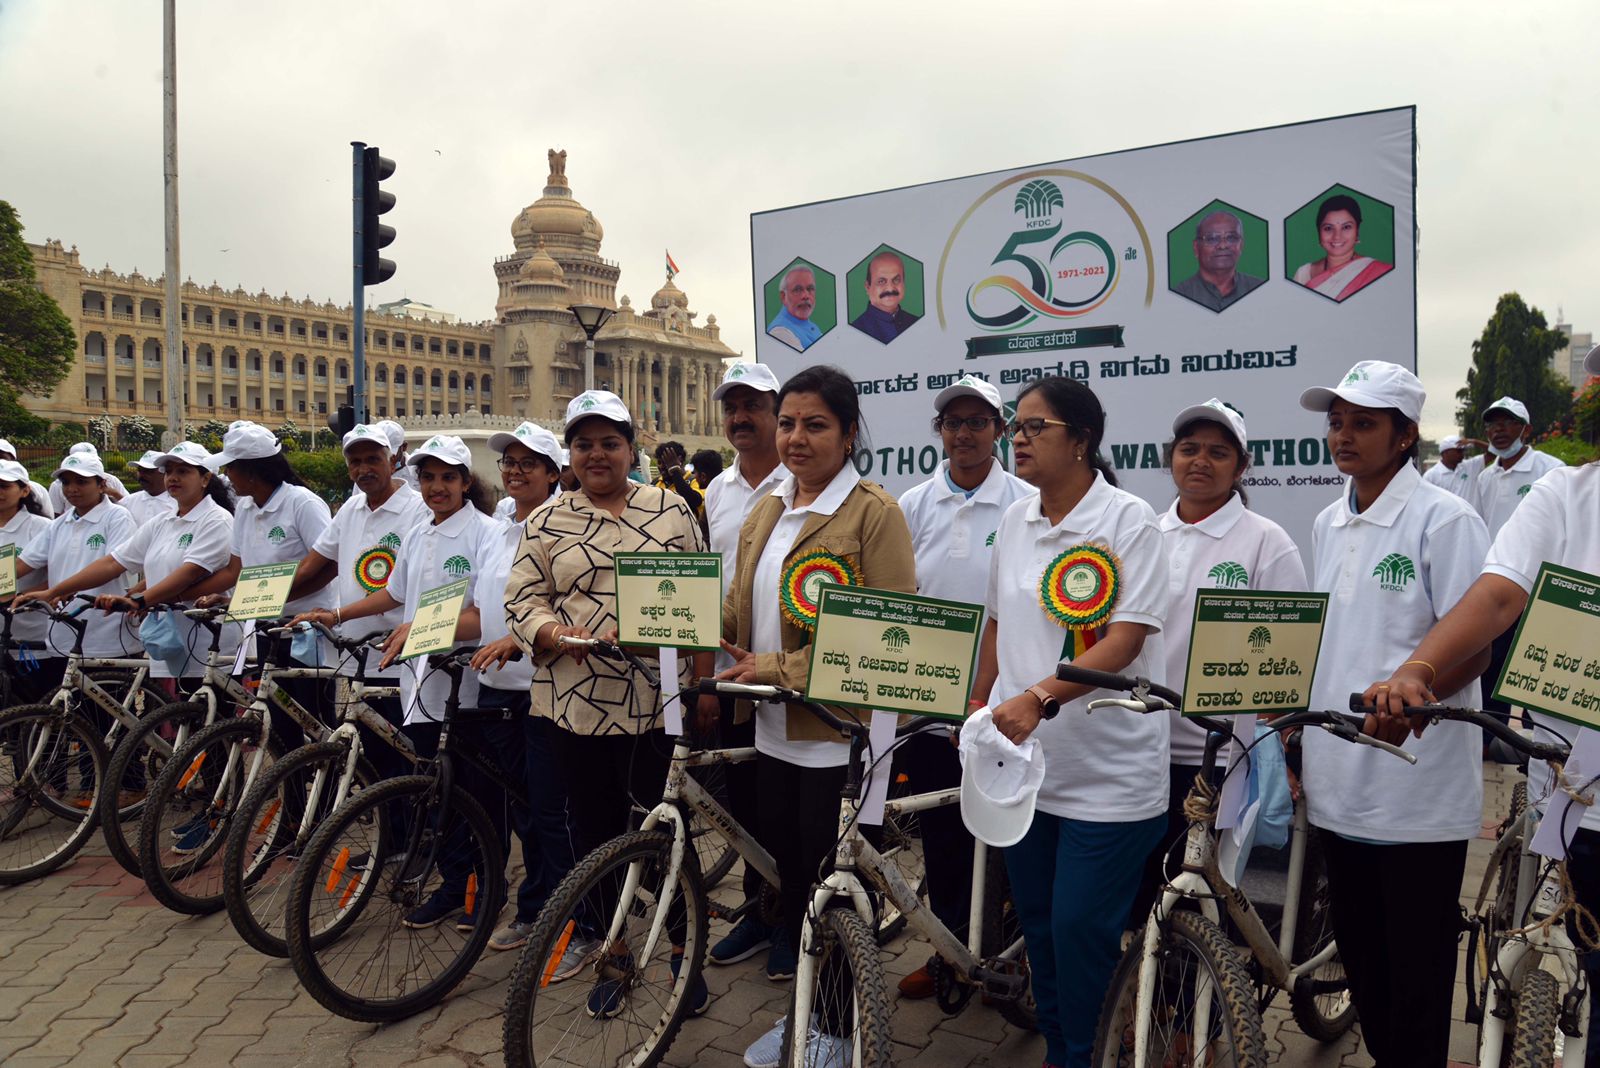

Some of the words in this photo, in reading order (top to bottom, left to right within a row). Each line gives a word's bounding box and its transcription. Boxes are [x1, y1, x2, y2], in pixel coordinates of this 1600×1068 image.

[1026, 219, 1052, 229] KFDC
[1057, 266, 1106, 279] 1971-2021
[1008, 331, 1077, 350] ವರ್ಷಾಚರಣೆ
[854, 372, 919, 396] ರ್ನಾಟಕ
[1100, 354, 1170, 378] ನಿಗಮ
[1181, 345, 1298, 373] ನಿಯಮಿತ
[1287, 475, 1345, 487] ಬೆಂಗಳೂರು
[1380, 584, 1405, 592] KFDCL
[1551, 576, 1596, 597] ಕರ್ನಾಟಕ
[640, 605, 666, 621] ಅಕ್ಷರ
[638, 625, 672, 638] ಪರಿಸರ
[677, 627, 699, 644] ಚಿನ್ನ
[822, 650, 851, 674] ನಮ್ಮ
[858, 655, 909, 674] ನಿಜವಾದ
[915, 661, 961, 685] ಸಂಪತ್ತು
[1202, 658, 1249, 677] ಕಾಡು
[1258, 657, 1302, 677] ಬೆಳೆಸಿ,
[1524, 643, 1549, 672] ನಿಮ್ಮ
[1553, 651, 1583, 674] ವಂಶ
[841, 678, 869, 701] ನಮ್ಮ
[877, 682, 936, 703] ಕಾಡುಗಳು
[1505, 669, 1540, 692] ಮಗನ
[1541, 680, 1571, 702] ವಂಶ
[1196, 688, 1243, 707] ನಾಡು
[1252, 689, 1299, 706] ಉಳಿಸಿ
